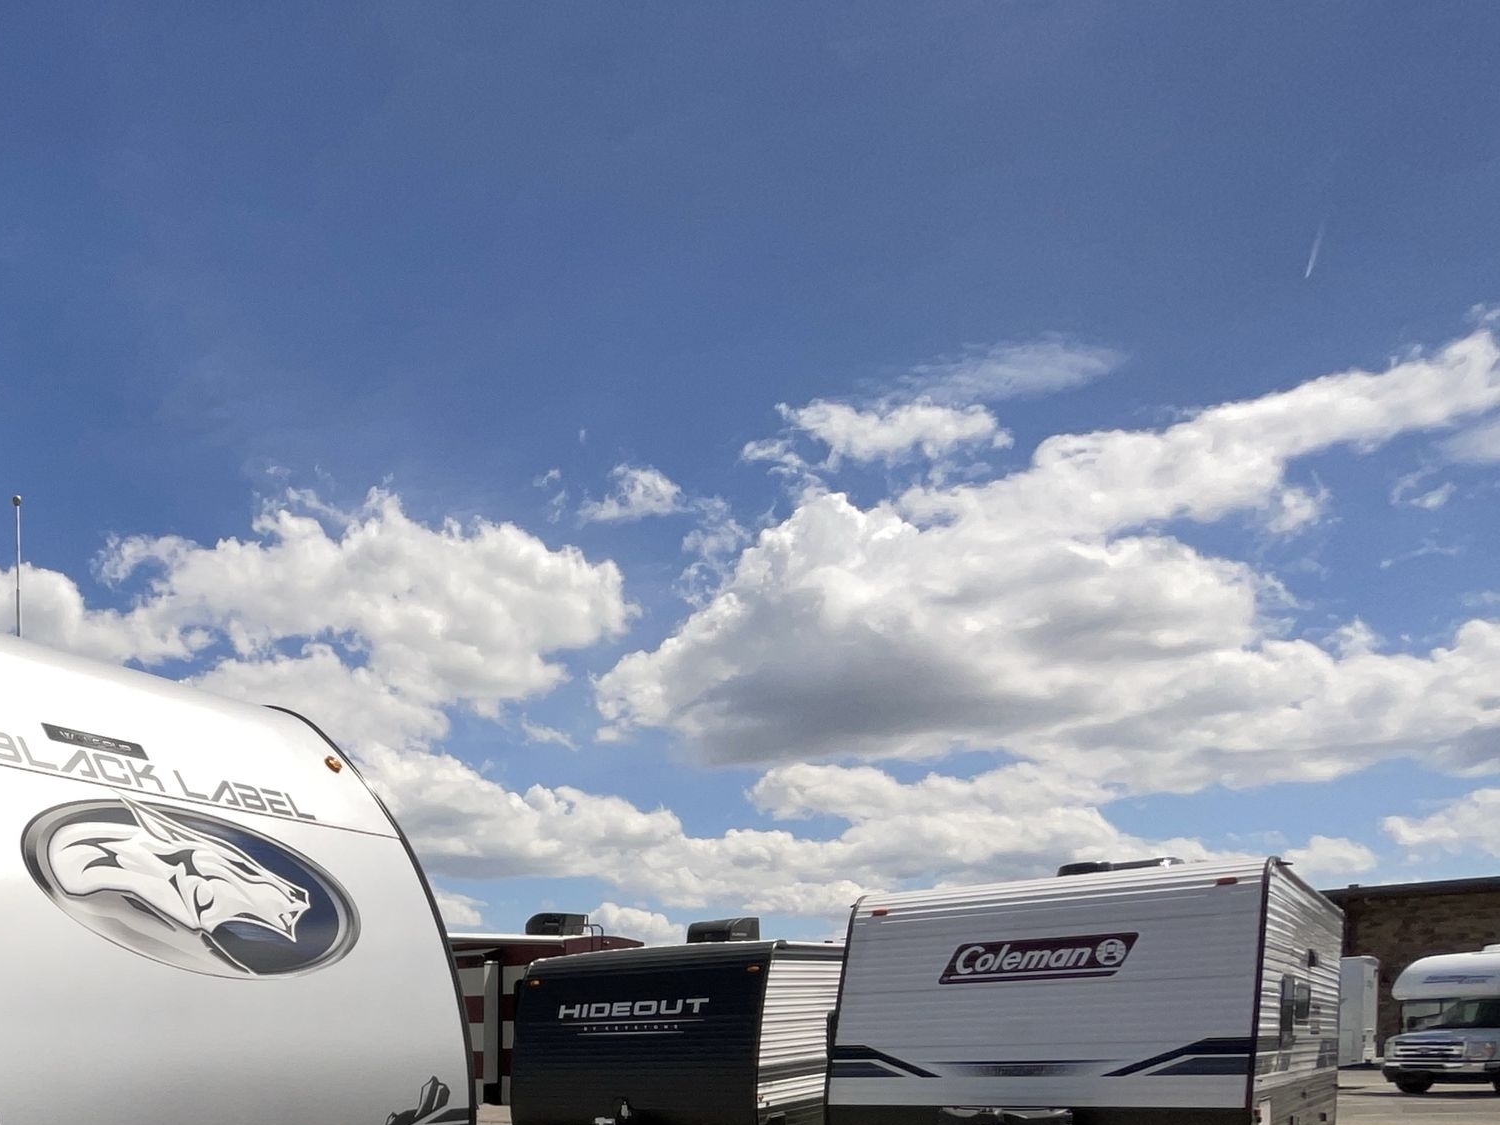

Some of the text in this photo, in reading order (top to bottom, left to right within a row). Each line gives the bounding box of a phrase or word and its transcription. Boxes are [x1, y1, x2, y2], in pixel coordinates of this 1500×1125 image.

[173, 769, 317, 821] LABEL
[955, 943, 1093, 975] Coleman
[558, 997, 709, 1019] HIDEOUT
